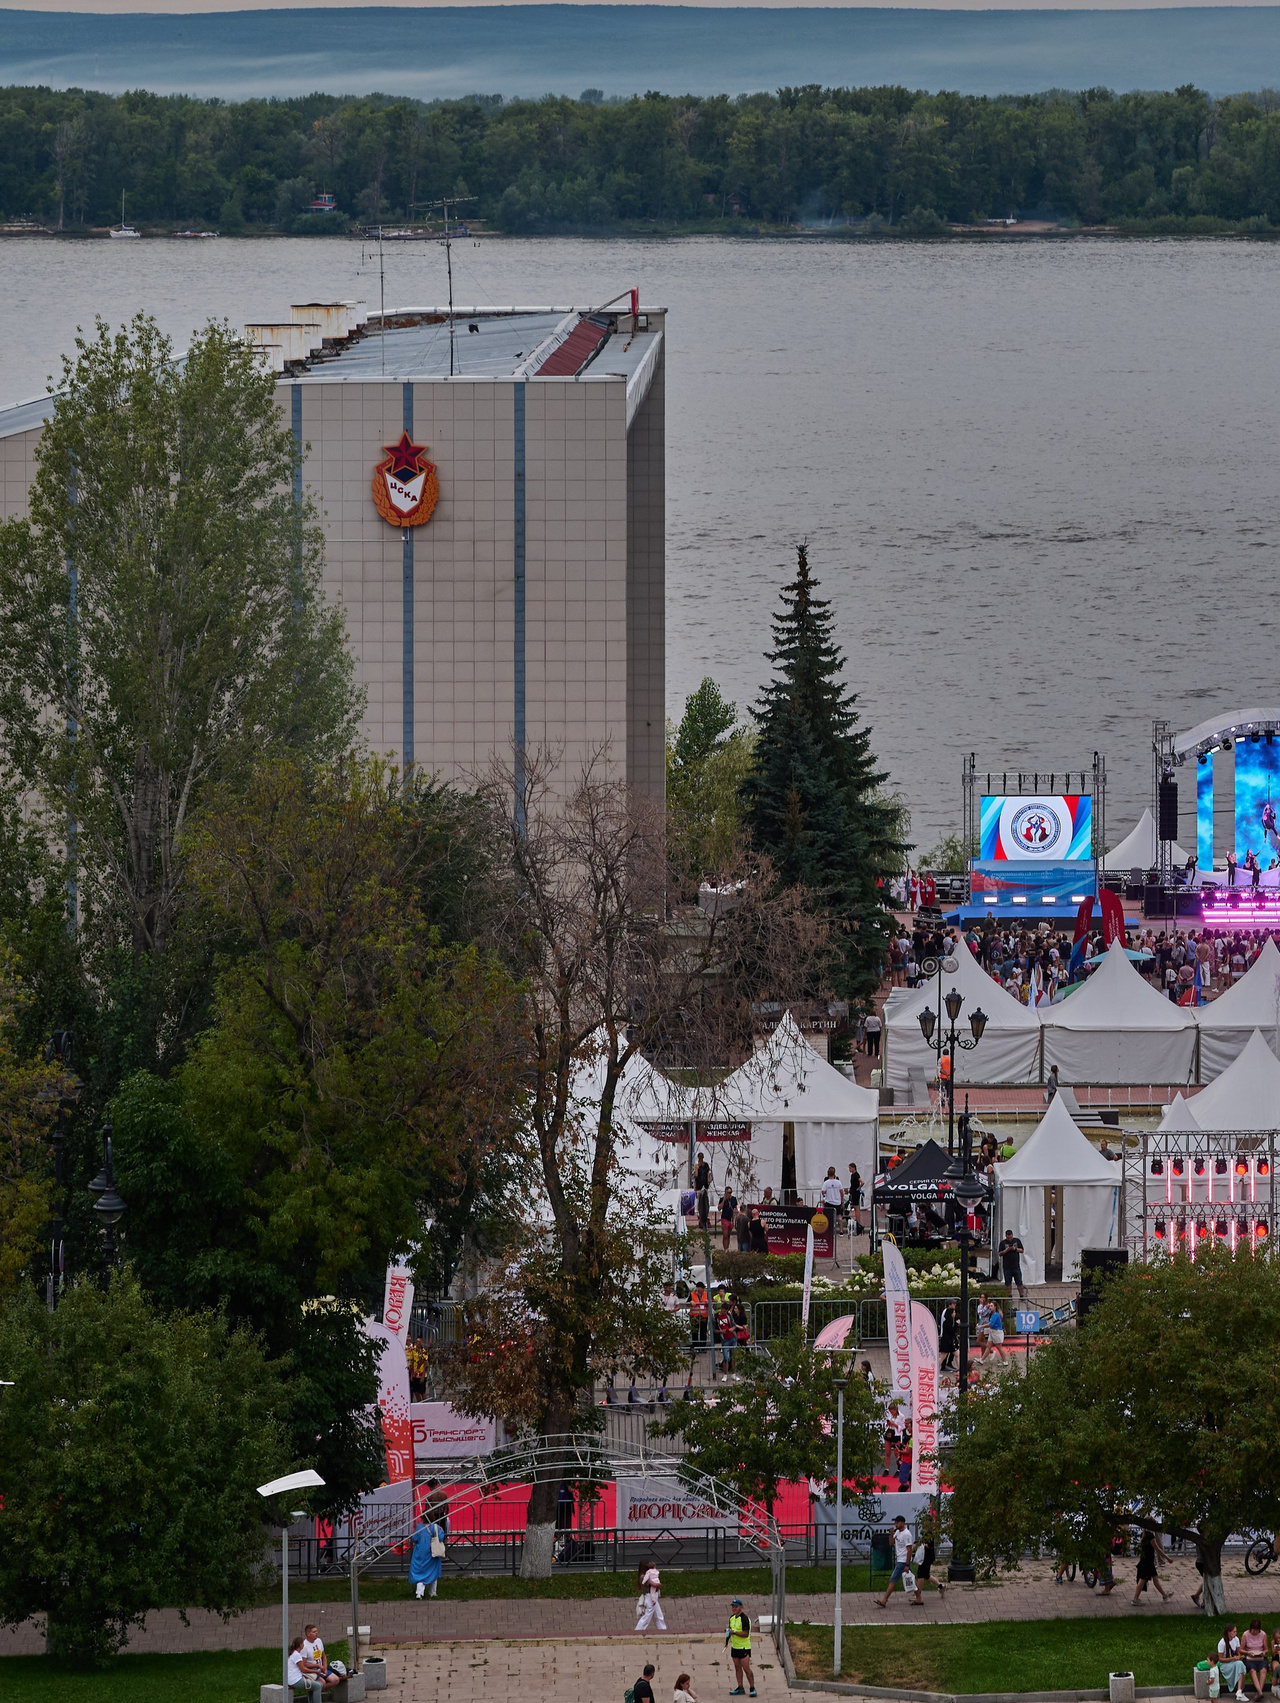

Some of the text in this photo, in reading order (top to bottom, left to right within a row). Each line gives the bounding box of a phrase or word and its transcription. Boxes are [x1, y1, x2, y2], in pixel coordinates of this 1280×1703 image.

[390, 482, 418, 502] ЦСКА
[800, 1020, 837, 1029] КАРТИН
[887, 1183, 953, 1191] VOLGAM
[910, 1192, 955, 1200] VOLGAMAN
[1020, 1313, 1036, 1325] 10
